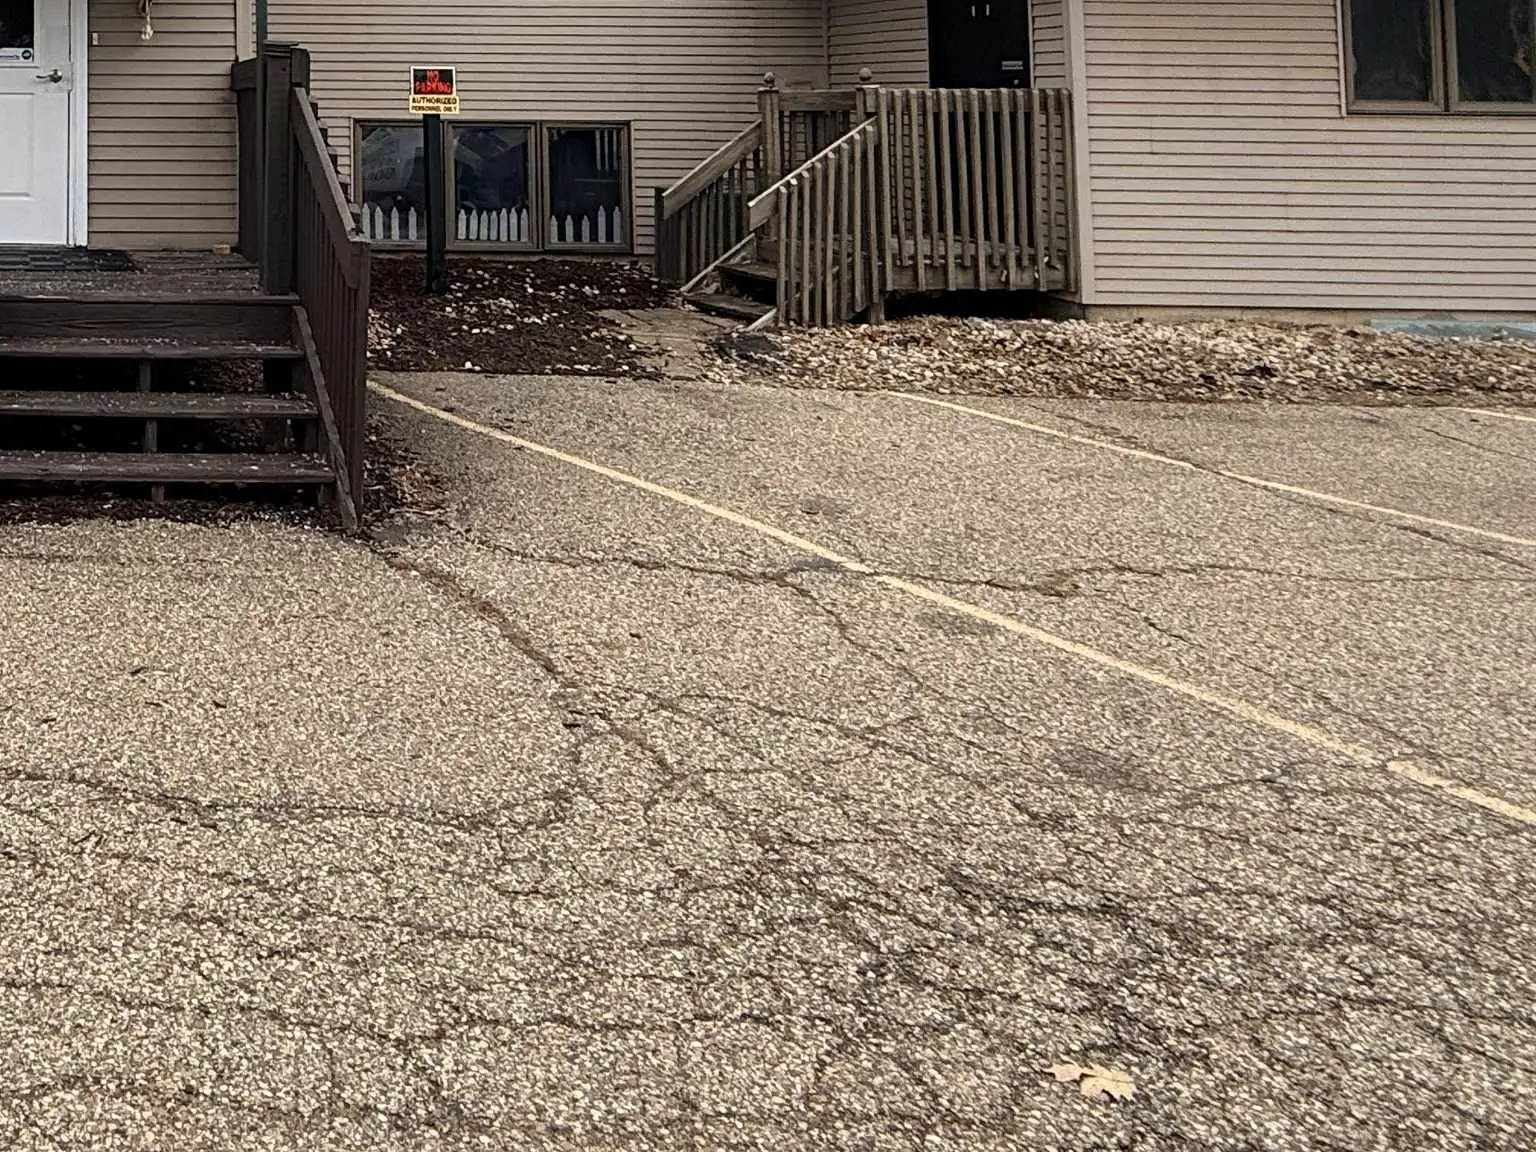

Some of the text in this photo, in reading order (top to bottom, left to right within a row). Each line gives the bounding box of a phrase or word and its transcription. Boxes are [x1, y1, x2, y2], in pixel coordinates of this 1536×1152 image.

[426, 70, 439, 82] NO
[415, 81, 451, 93] PARKING
[412, 96, 457, 105] AUTHORIZED
